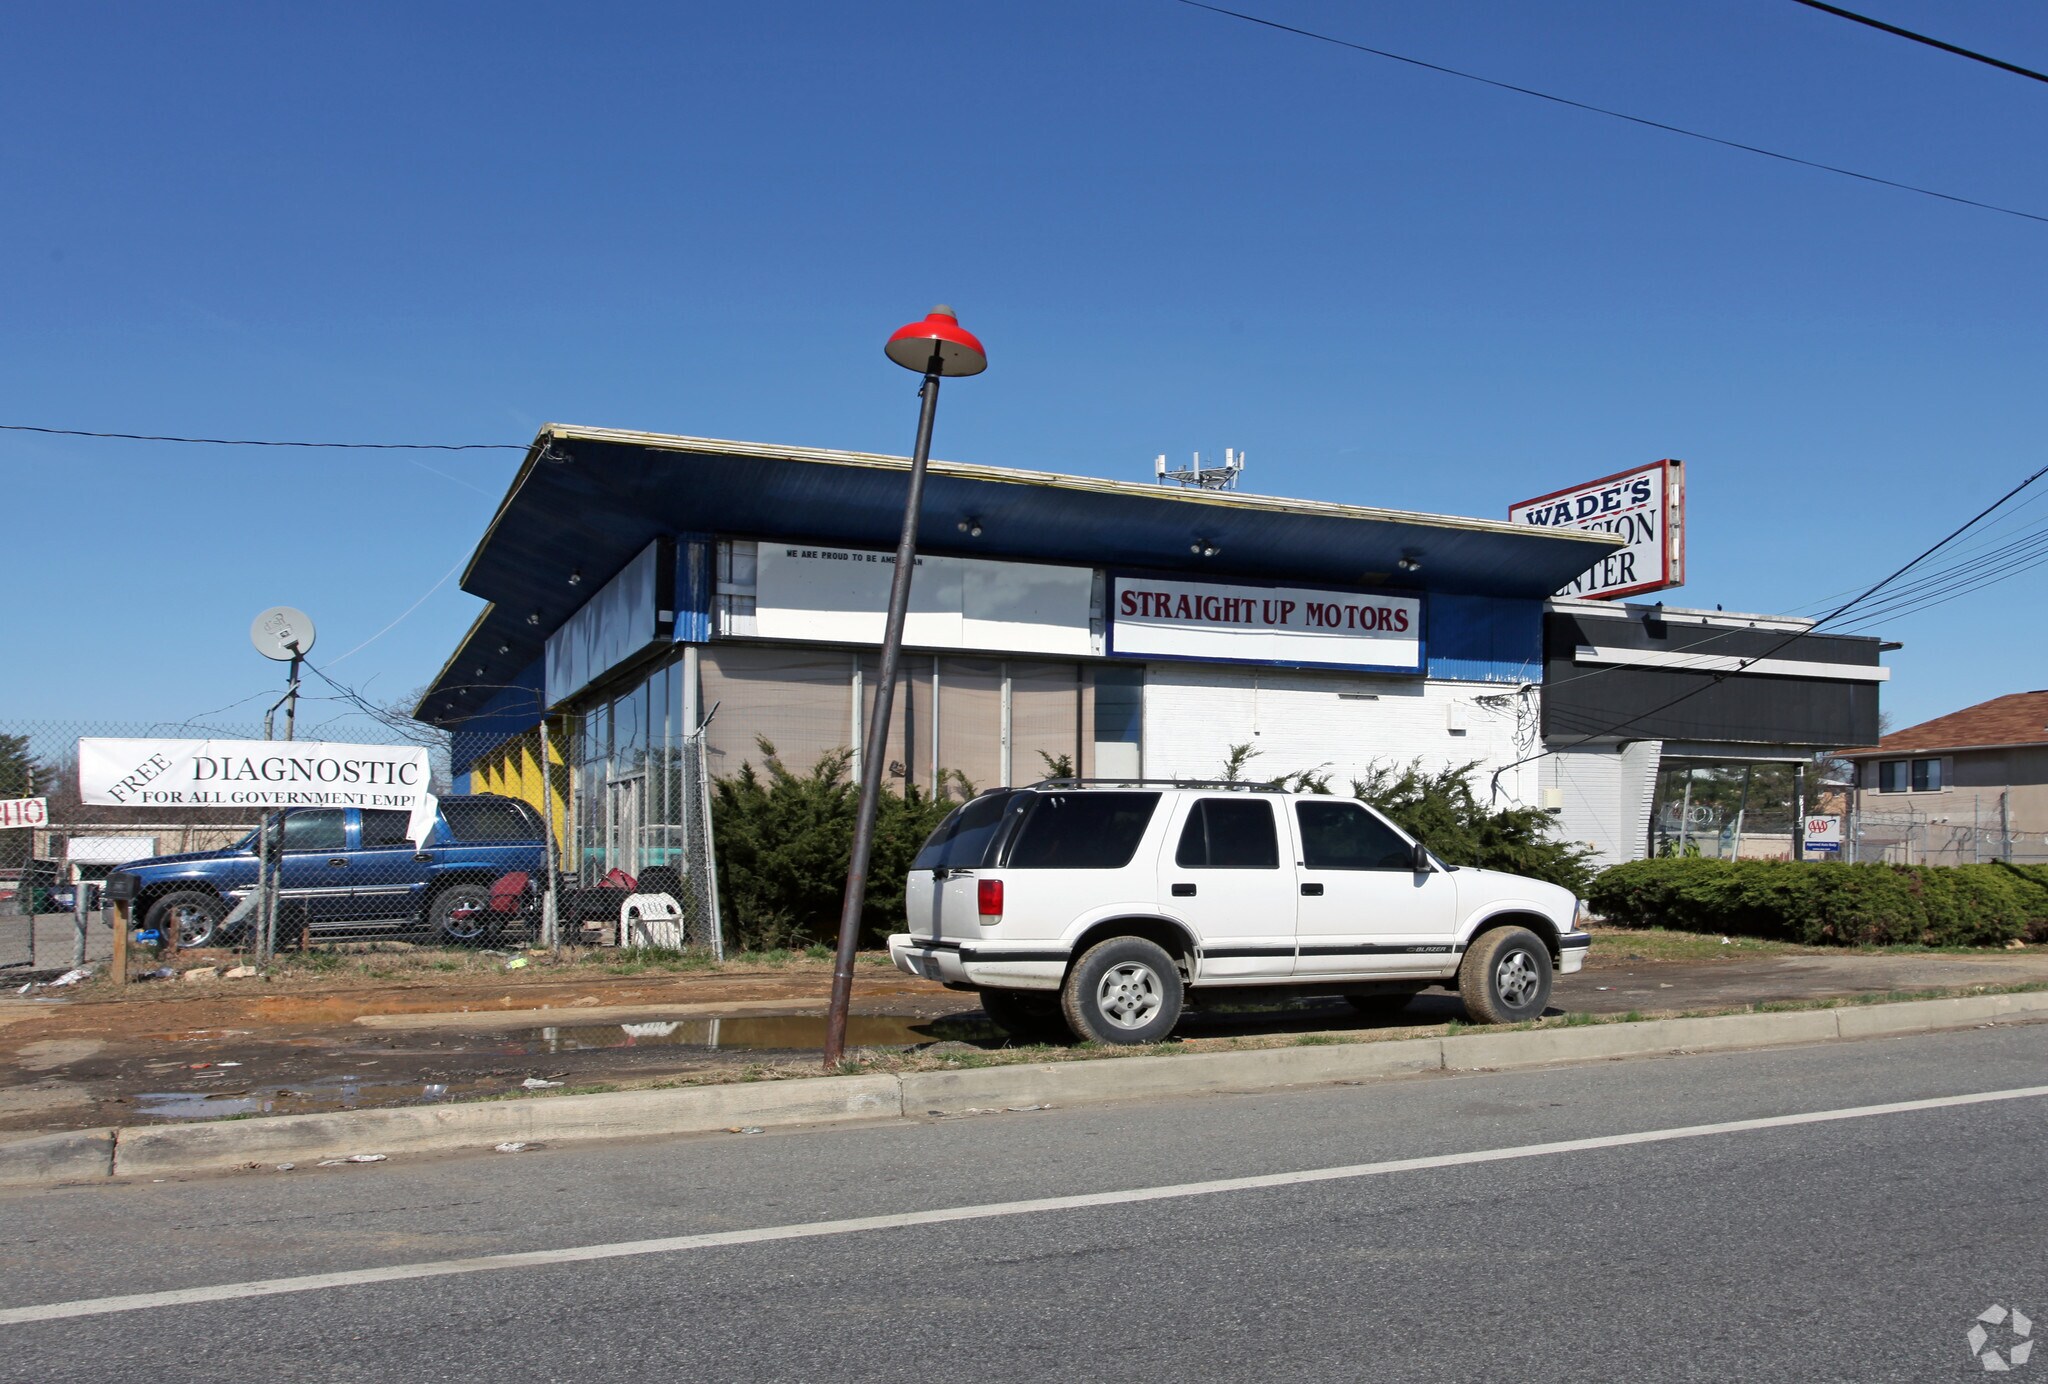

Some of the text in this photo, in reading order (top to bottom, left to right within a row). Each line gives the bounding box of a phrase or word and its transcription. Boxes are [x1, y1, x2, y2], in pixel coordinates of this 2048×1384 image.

[1526, 478, 1651, 525] WADE'S
[801, 551, 818, 559] ARE
[821, 551, 848, 561] PROUD
[852, 553, 863, 562] TO
[866, 554, 877, 562] BE
[881, 556, 923, 565] AMEAN
[1555, 552, 1637, 596] NTER
[1120, 589, 1409, 633] STRAIGHT UP MOTORS
[107, 753, 173, 804] FREE
[192, 756, 418, 786] DIAGNOSTIC
[142, 791, 183, 803] FOR
[189, 791, 227, 804] ALL
[231, 791, 367, 806] GOVERNMENT
